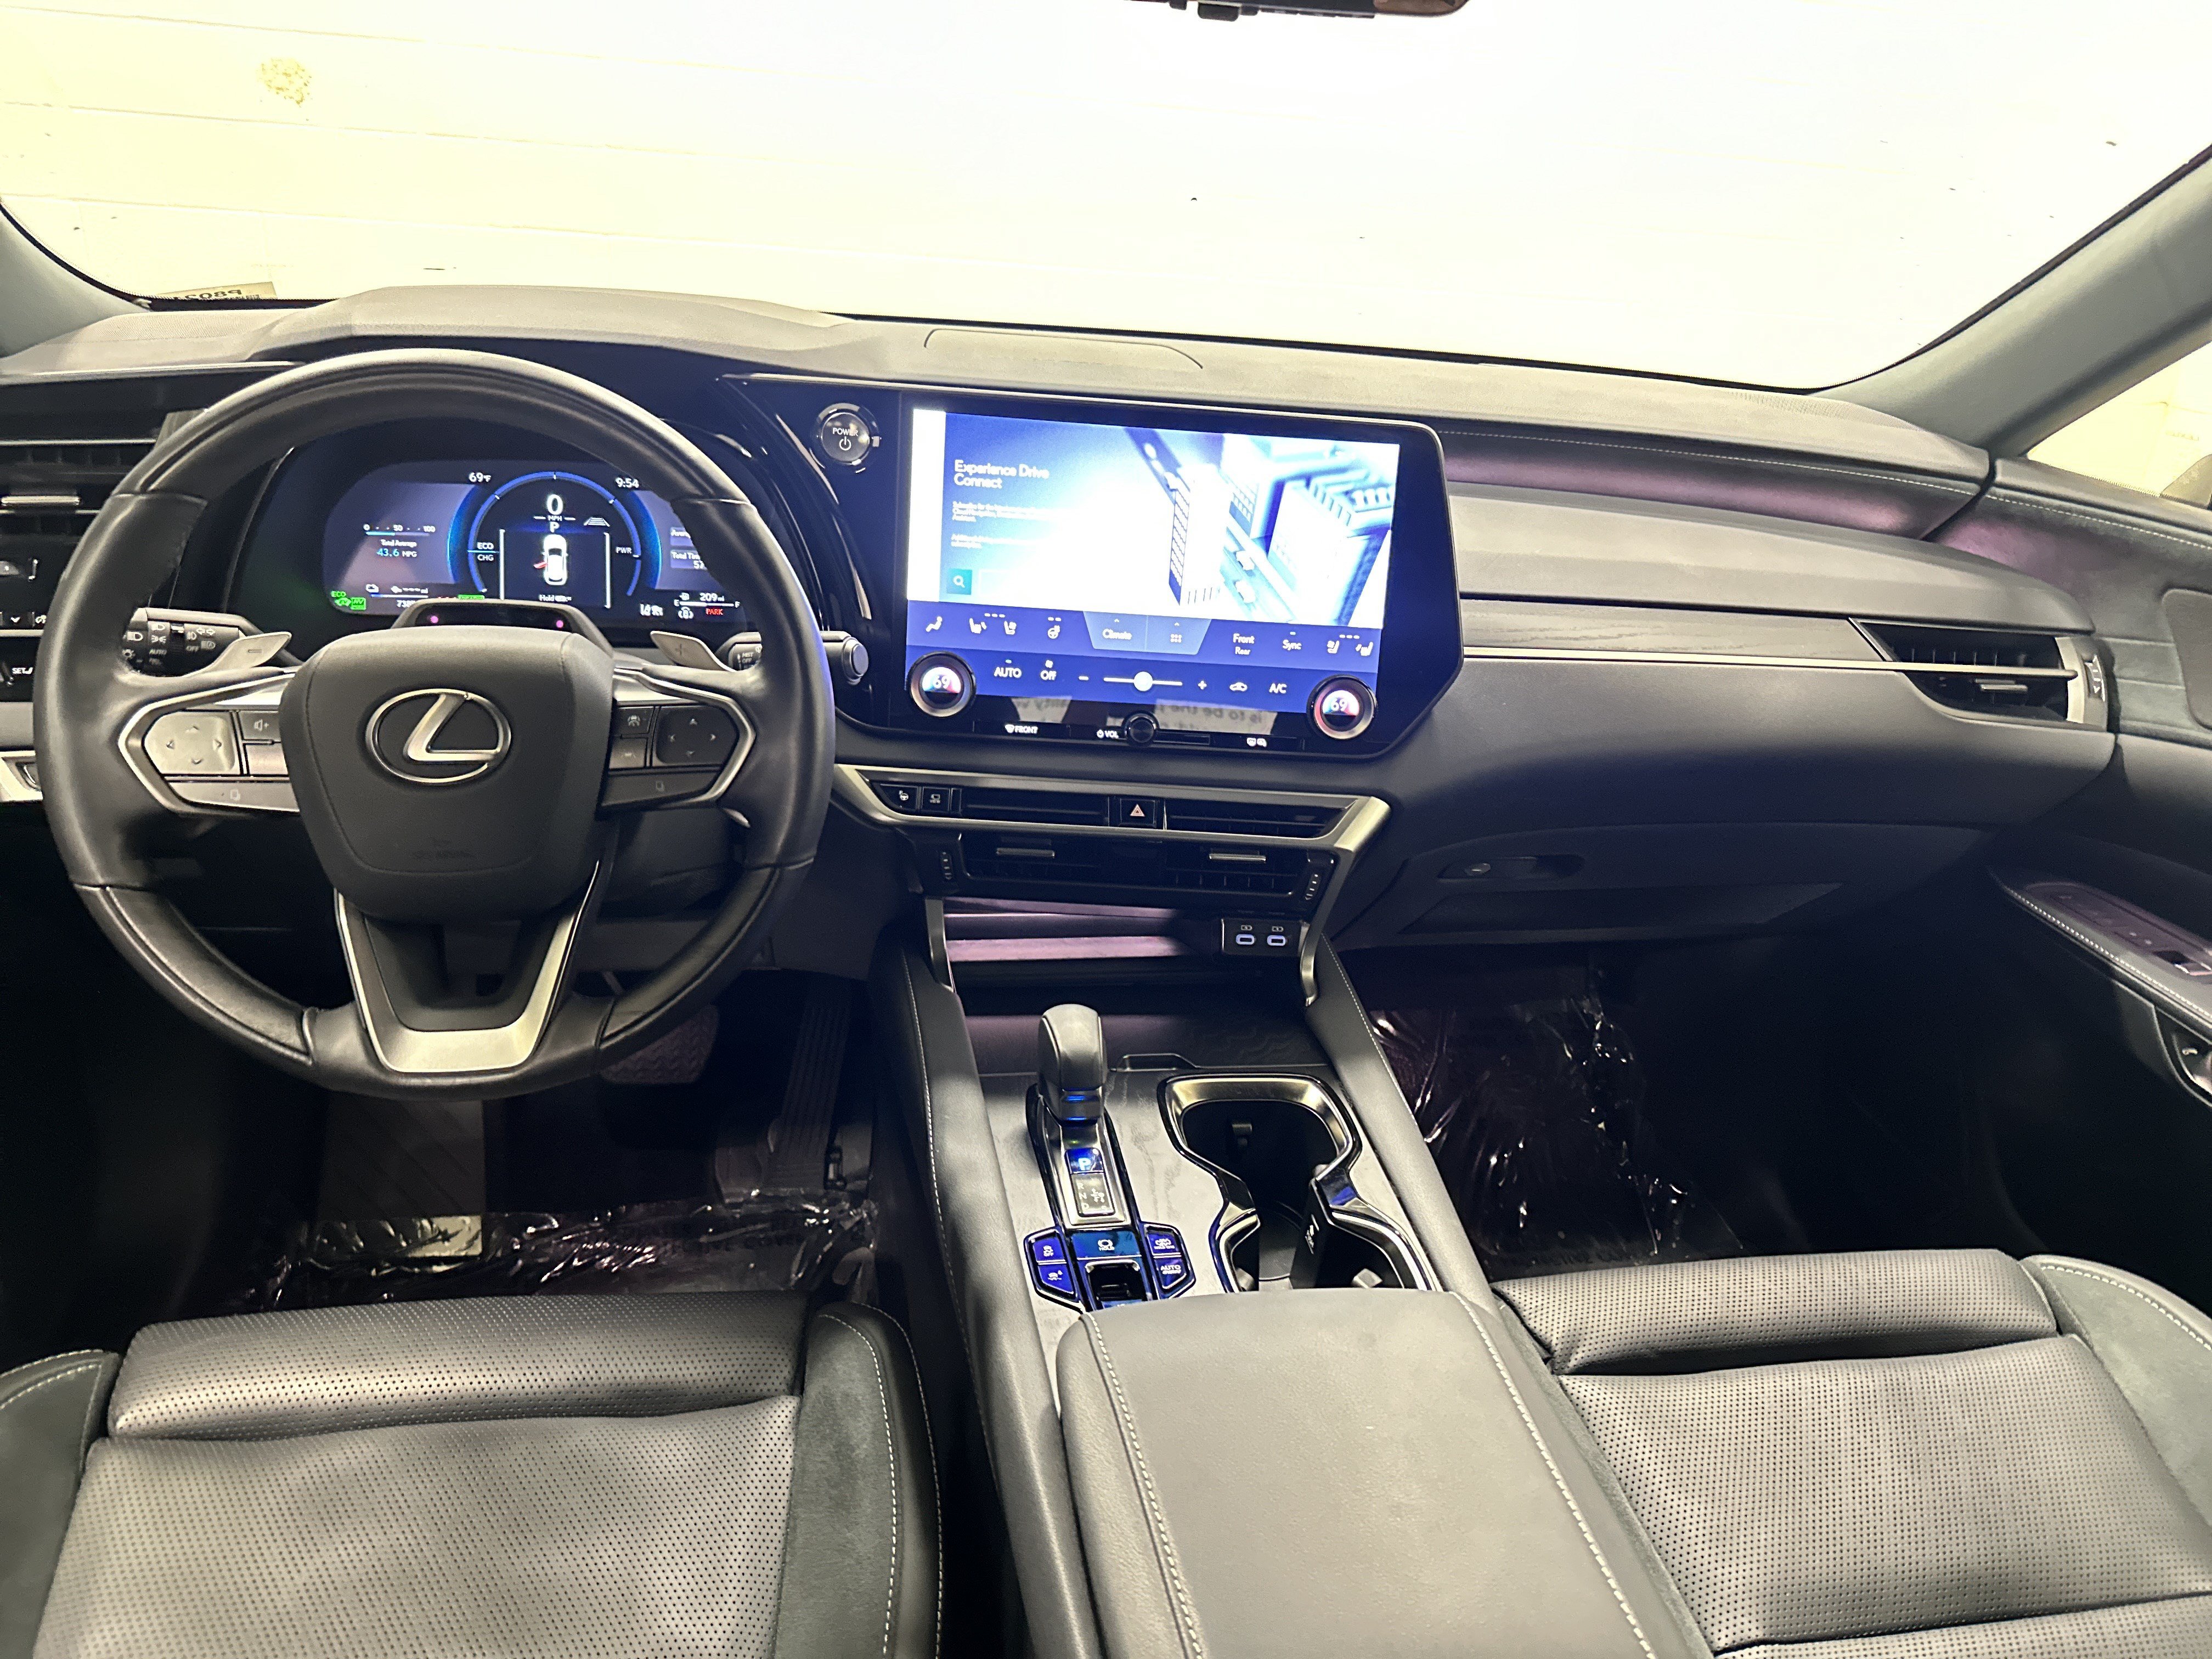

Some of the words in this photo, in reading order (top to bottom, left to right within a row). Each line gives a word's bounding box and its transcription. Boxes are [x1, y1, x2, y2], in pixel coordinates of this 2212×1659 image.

[832, 427, 859, 437] POWER
[955, 459, 1017, 476] Experience
[1019, 464, 1049, 479] Drive
[616, 478, 640, 488] 9:54
[953, 473, 1002, 489] Connect
[546, 494, 563, 515] 0
[550, 522, 560, 533] P
[377, 549, 399, 557] 43.6
[699, 592, 718, 601] 209
[1102, 629, 1132, 641] Climate
[1233, 633, 1255, 645] Front
[1235, 646, 1251, 656] Rear
[1282, 639, 1302, 651] Sync
[994, 666, 1022, 678] AUTO
[1041, 669, 1058, 681] Off
[932, 675, 950, 689] 69
[1269, 682, 1288, 694] A/C
[1330, 699, 1348, 711] 69
[1015, 725, 1039, 734] FRONT
[1104, 730, 1119, 738] VOL
[1079, 1158, 1091, 1171] P
